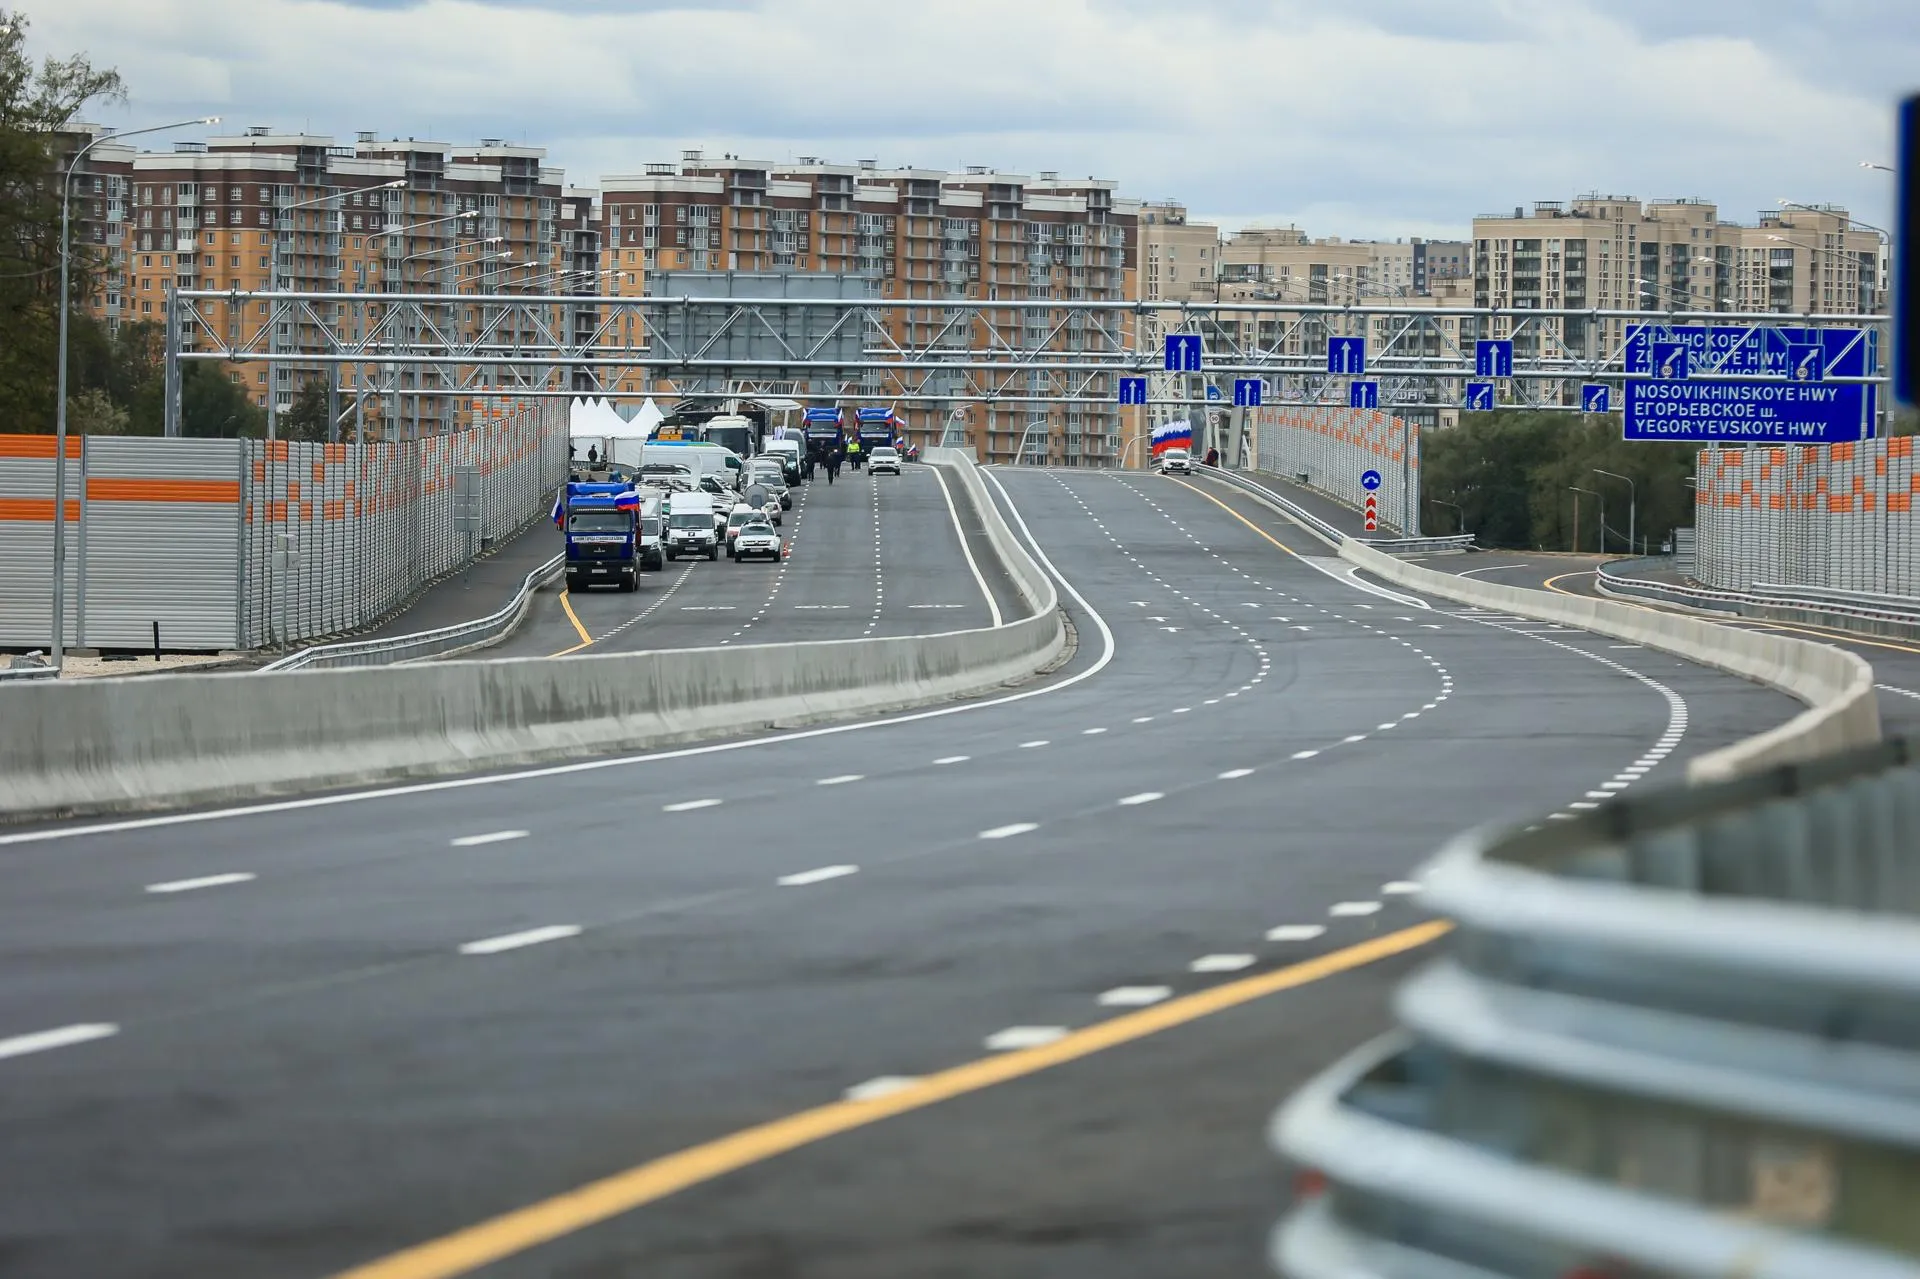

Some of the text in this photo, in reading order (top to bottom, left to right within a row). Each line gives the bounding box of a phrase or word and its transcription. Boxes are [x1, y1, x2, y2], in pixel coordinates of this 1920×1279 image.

[1635, 385, 1838, 401] NOSOVIKHINSKOYE HWY
[1635, 402, 1778, 418] ЕГОРЬЕВСКОЕ ш.
[1789, 421, 1827, 436] HWY
